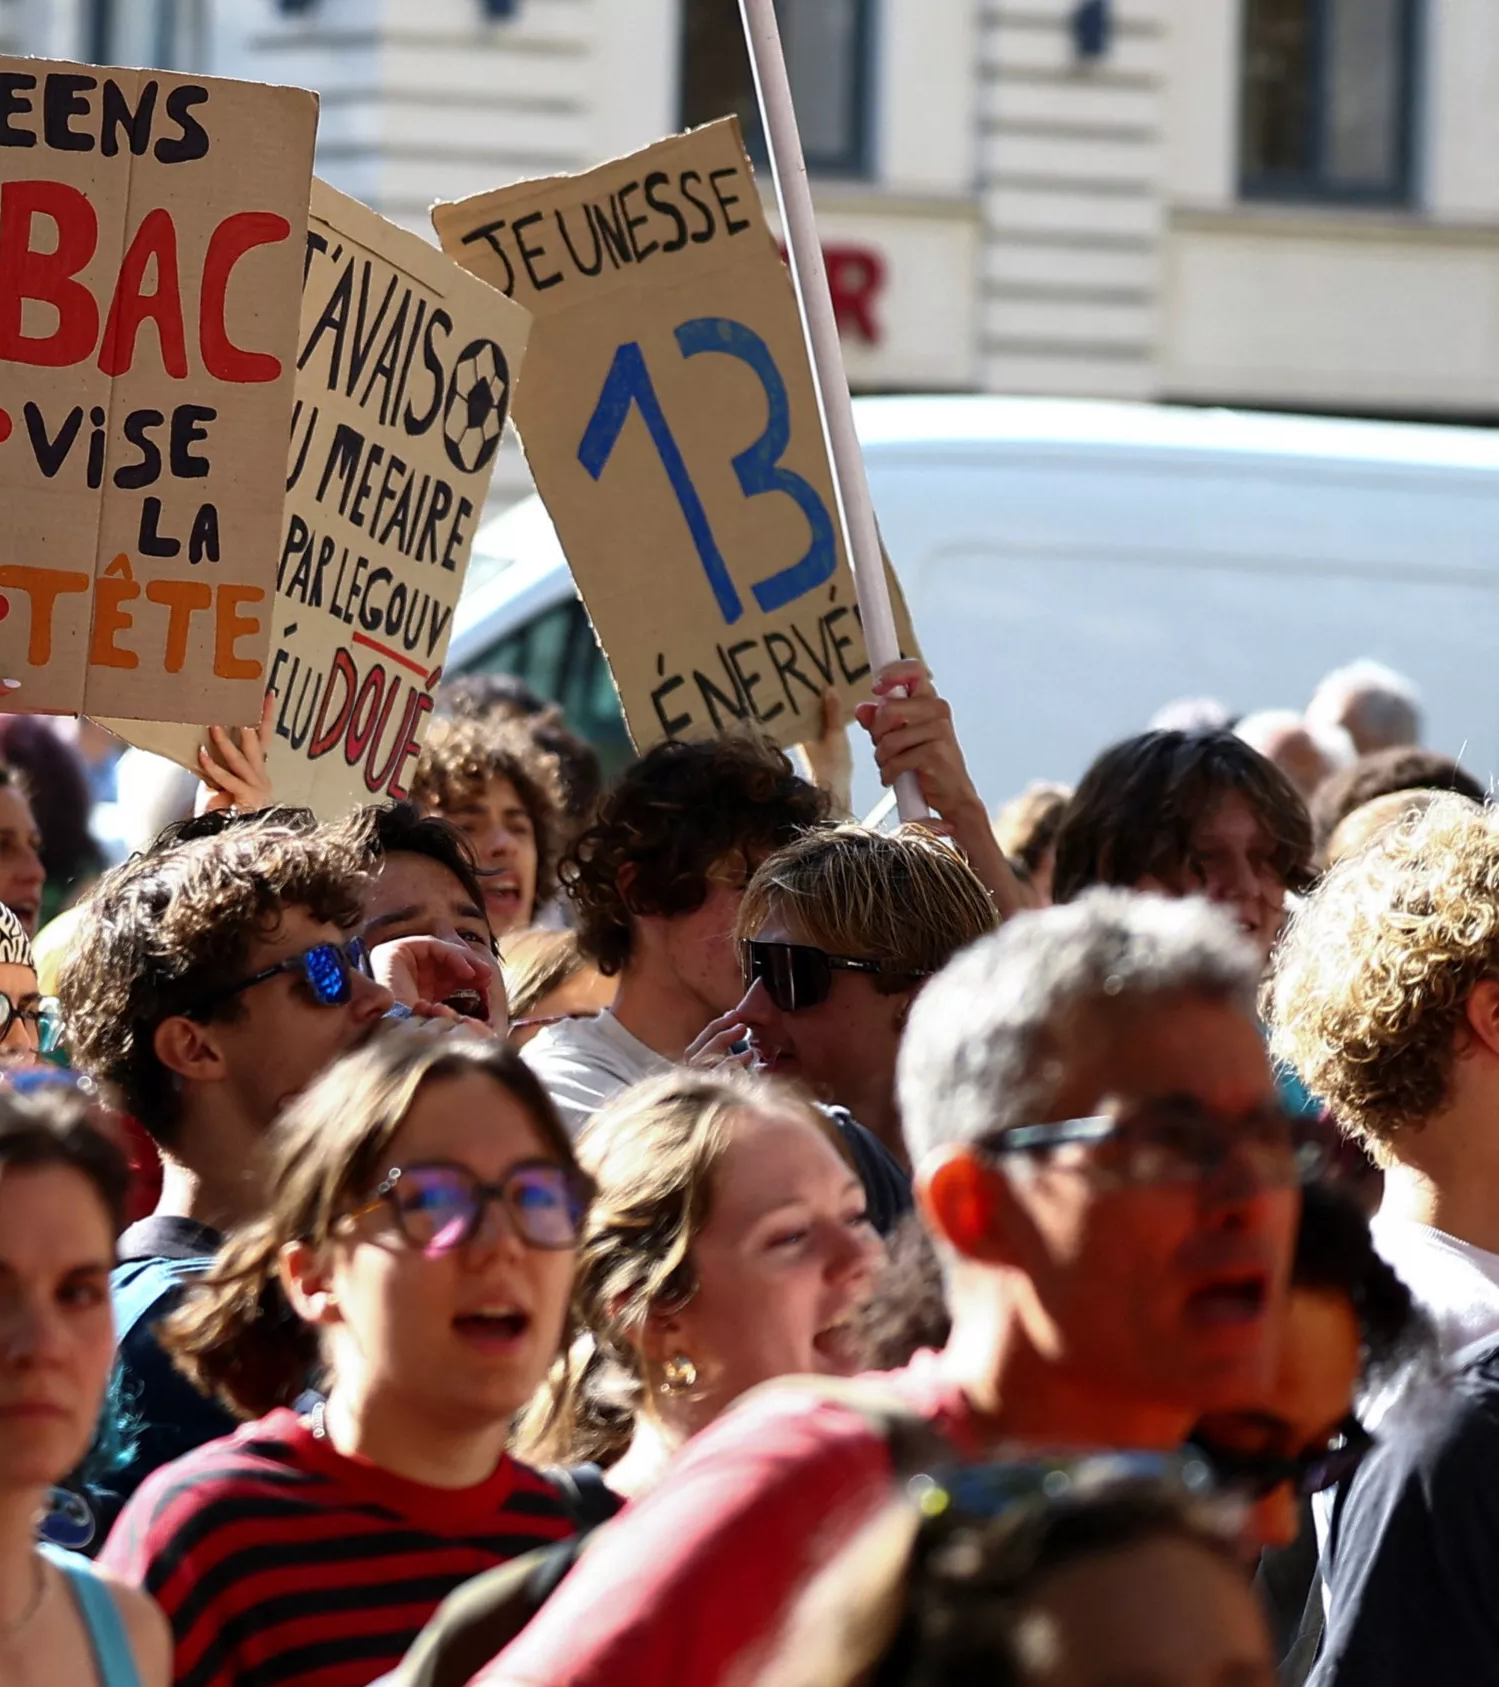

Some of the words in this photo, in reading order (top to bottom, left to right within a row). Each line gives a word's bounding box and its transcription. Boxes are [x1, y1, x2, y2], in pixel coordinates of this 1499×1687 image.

[461, 166, 751, 298] JEUNESSE
[137, 496, 221, 564] LA
[576, 316, 837, 626] 13
[307, 646, 442, 800] DOUÉ
[651, 584, 905, 738] ÉNERVÉ
